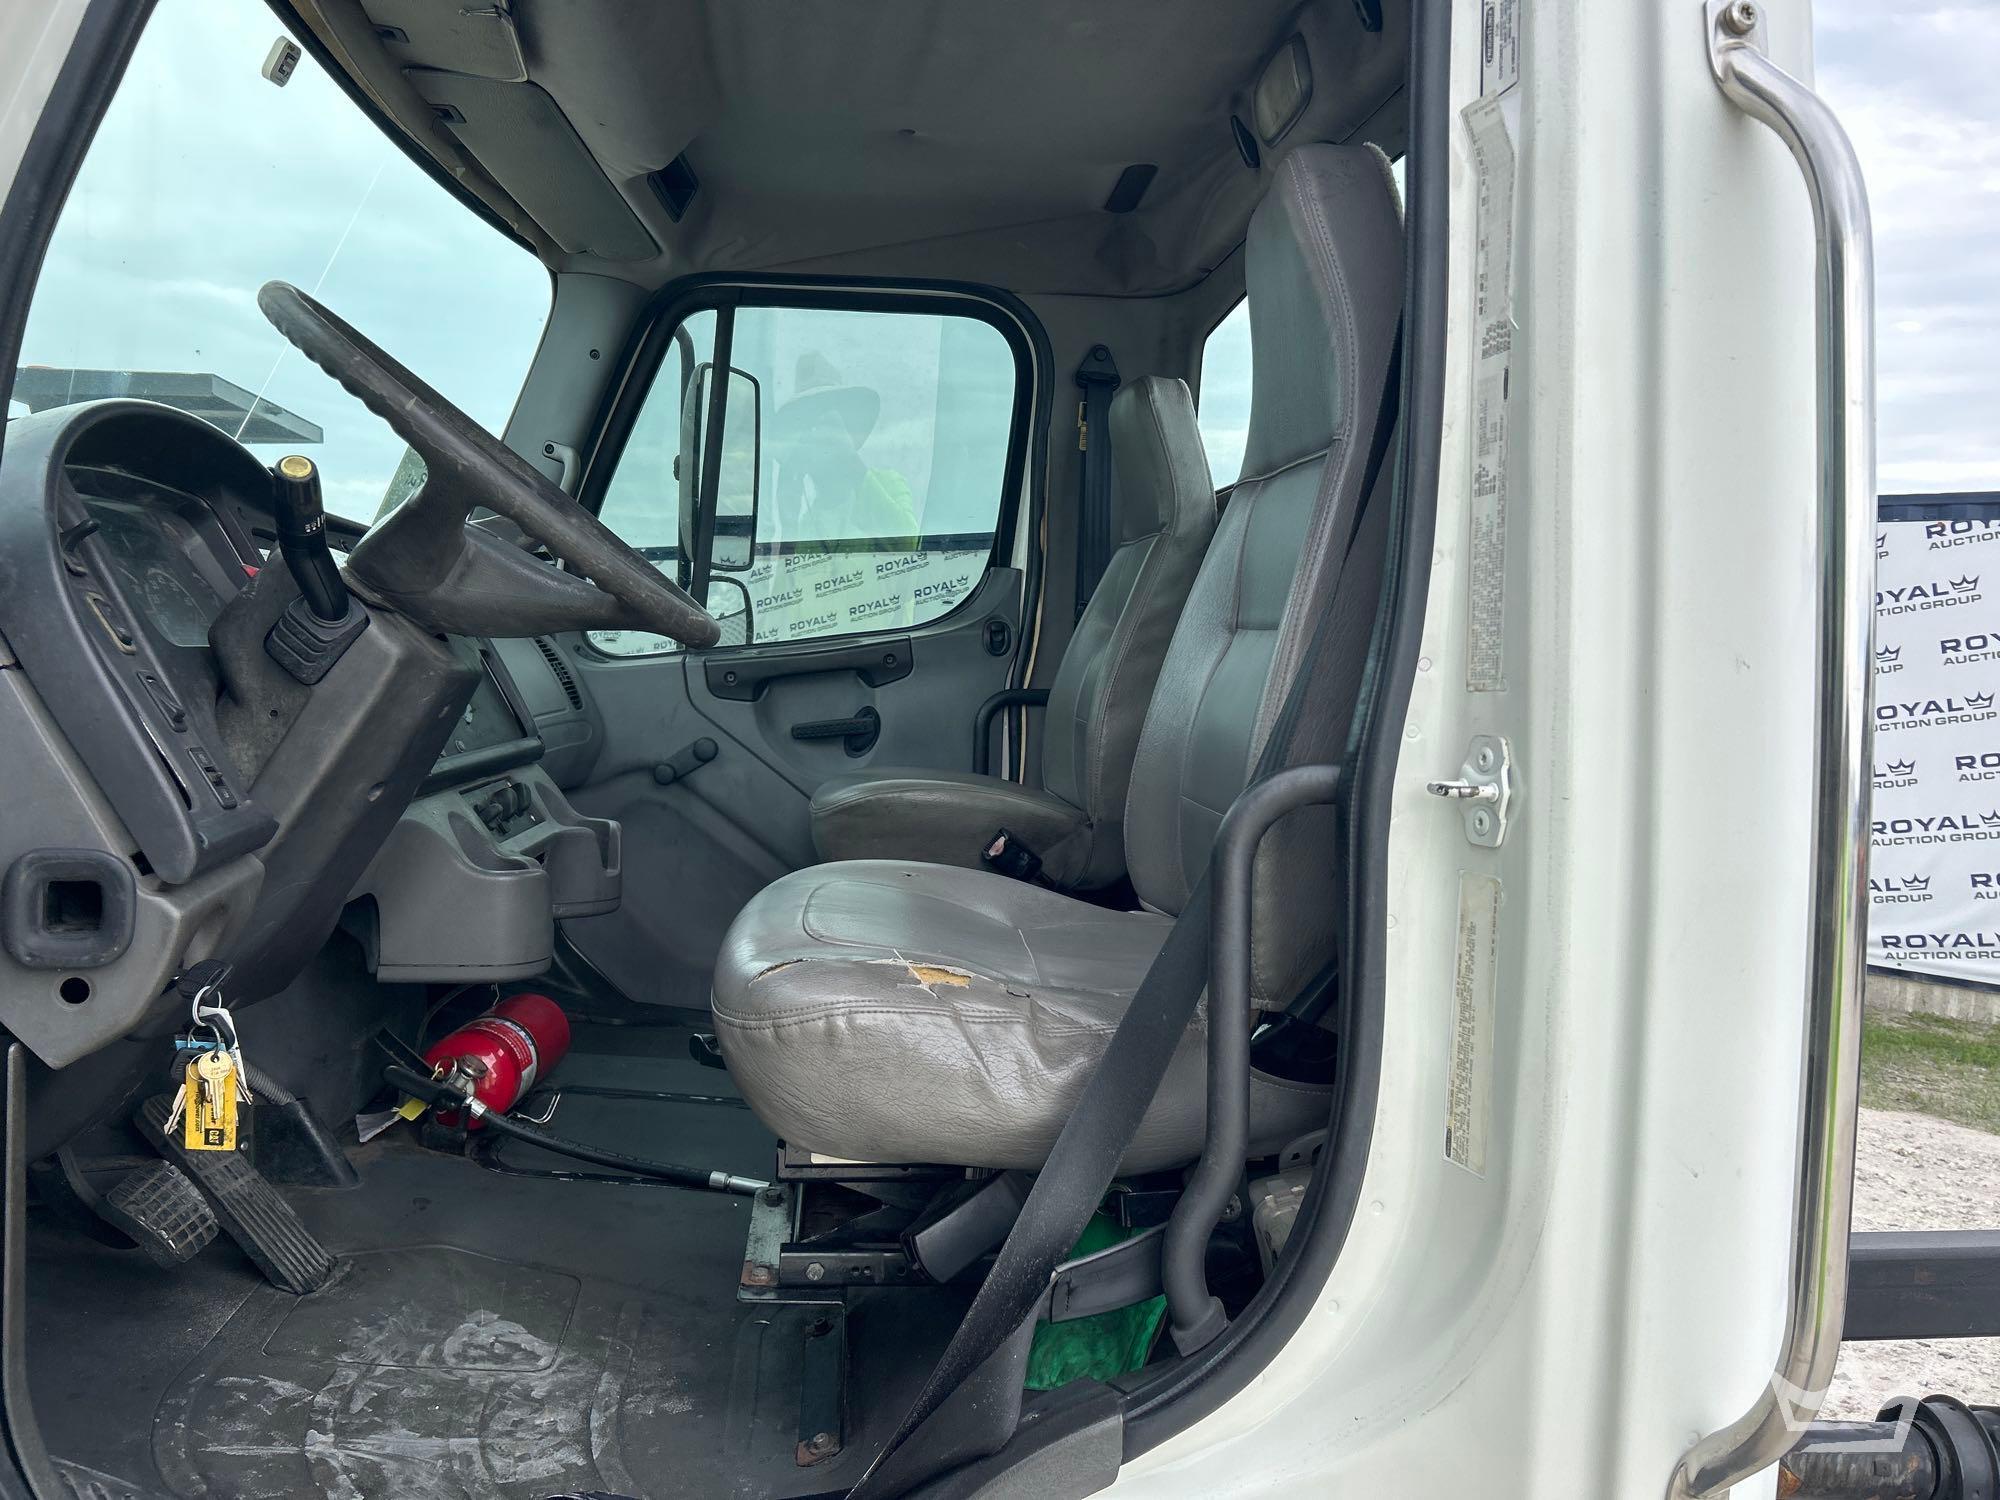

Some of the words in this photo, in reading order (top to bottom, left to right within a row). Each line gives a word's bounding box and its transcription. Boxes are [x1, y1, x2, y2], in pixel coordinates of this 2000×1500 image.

[1925, 520, 2000, 539] ROY
[876, 555, 917, 574] ROYAL
[750, 568, 763, 578] AL
[877, 569, 905, 580] AUCTION
[814, 575, 853, 592] ROYAL
[914, 580, 956, 599] ROYAL
[756, 592, 793, 608] ROYAL
[816, 588, 842, 598] AUCTION
[849, 598, 889, 616] ROYAL
[1876, 604, 1917, 617] TION
[1920, 594, 1983, 611] GROUP
[789, 615, 828, 632] ROYAL
[755, 631, 769, 641] AL
[1943, 651, 2000, 666] AUCTI
[1876, 698, 1964, 720] OYAL
[1935, 711, 1997, 726] GROUP
[1955, 753, 2000, 770] RO
[1873, 778, 1918, 789] ROUP
[1872, 815, 1980, 835] ROYAL
[1872, 834, 1946, 847] AUCTION
[1950, 831, 2000, 842] GROU
[1869, 878, 1901, 892] AL
[1873, 894, 1933, 904] GROUP
[1881, 933, 1995, 949] ROYAL
[1885, 951, 1961, 960] AUCTION
[1965, 951, 2000, 960] GRO
[209, 1130, 220, 1144] CAT
